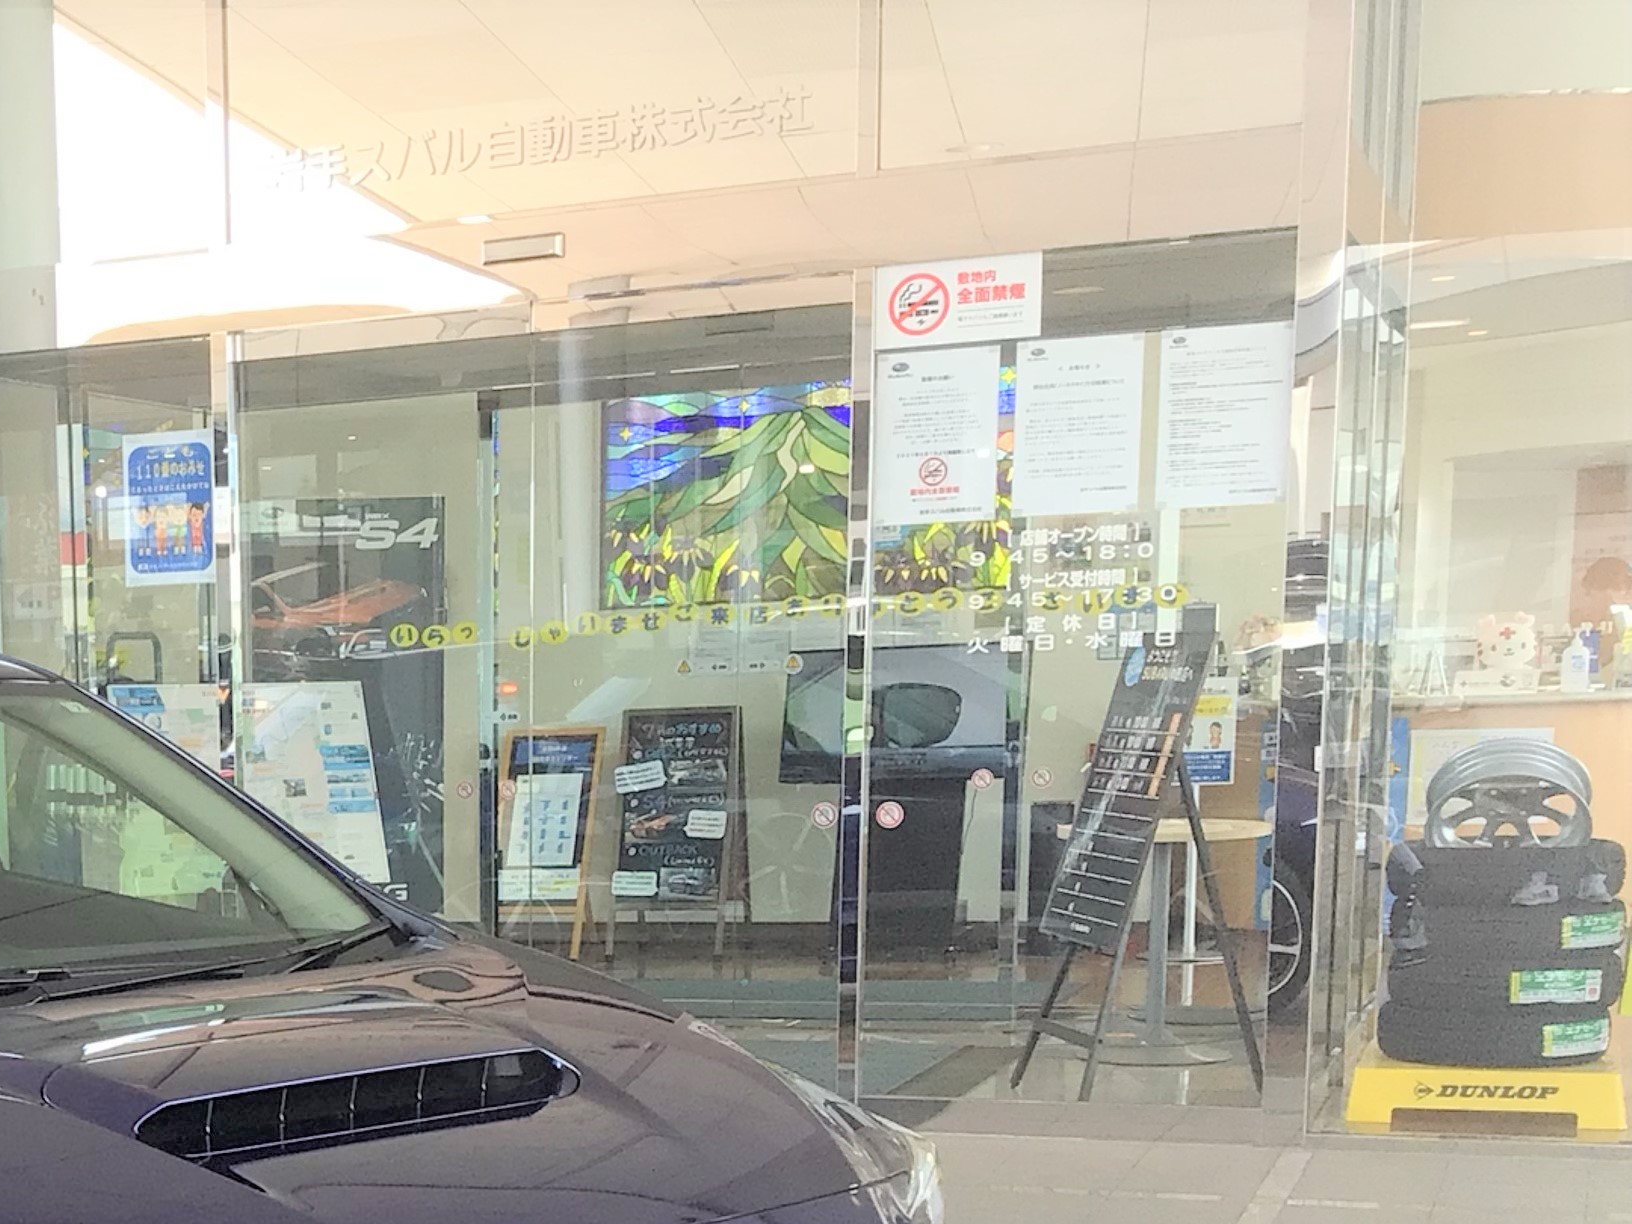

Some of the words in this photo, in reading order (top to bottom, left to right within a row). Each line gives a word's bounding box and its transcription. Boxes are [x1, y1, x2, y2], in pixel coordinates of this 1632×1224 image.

[957, 283, 1026, 305] 全面禁煙
[355, 518, 439, 549] S4
[1436, 1085, 1560, 1099] DUNLOP
